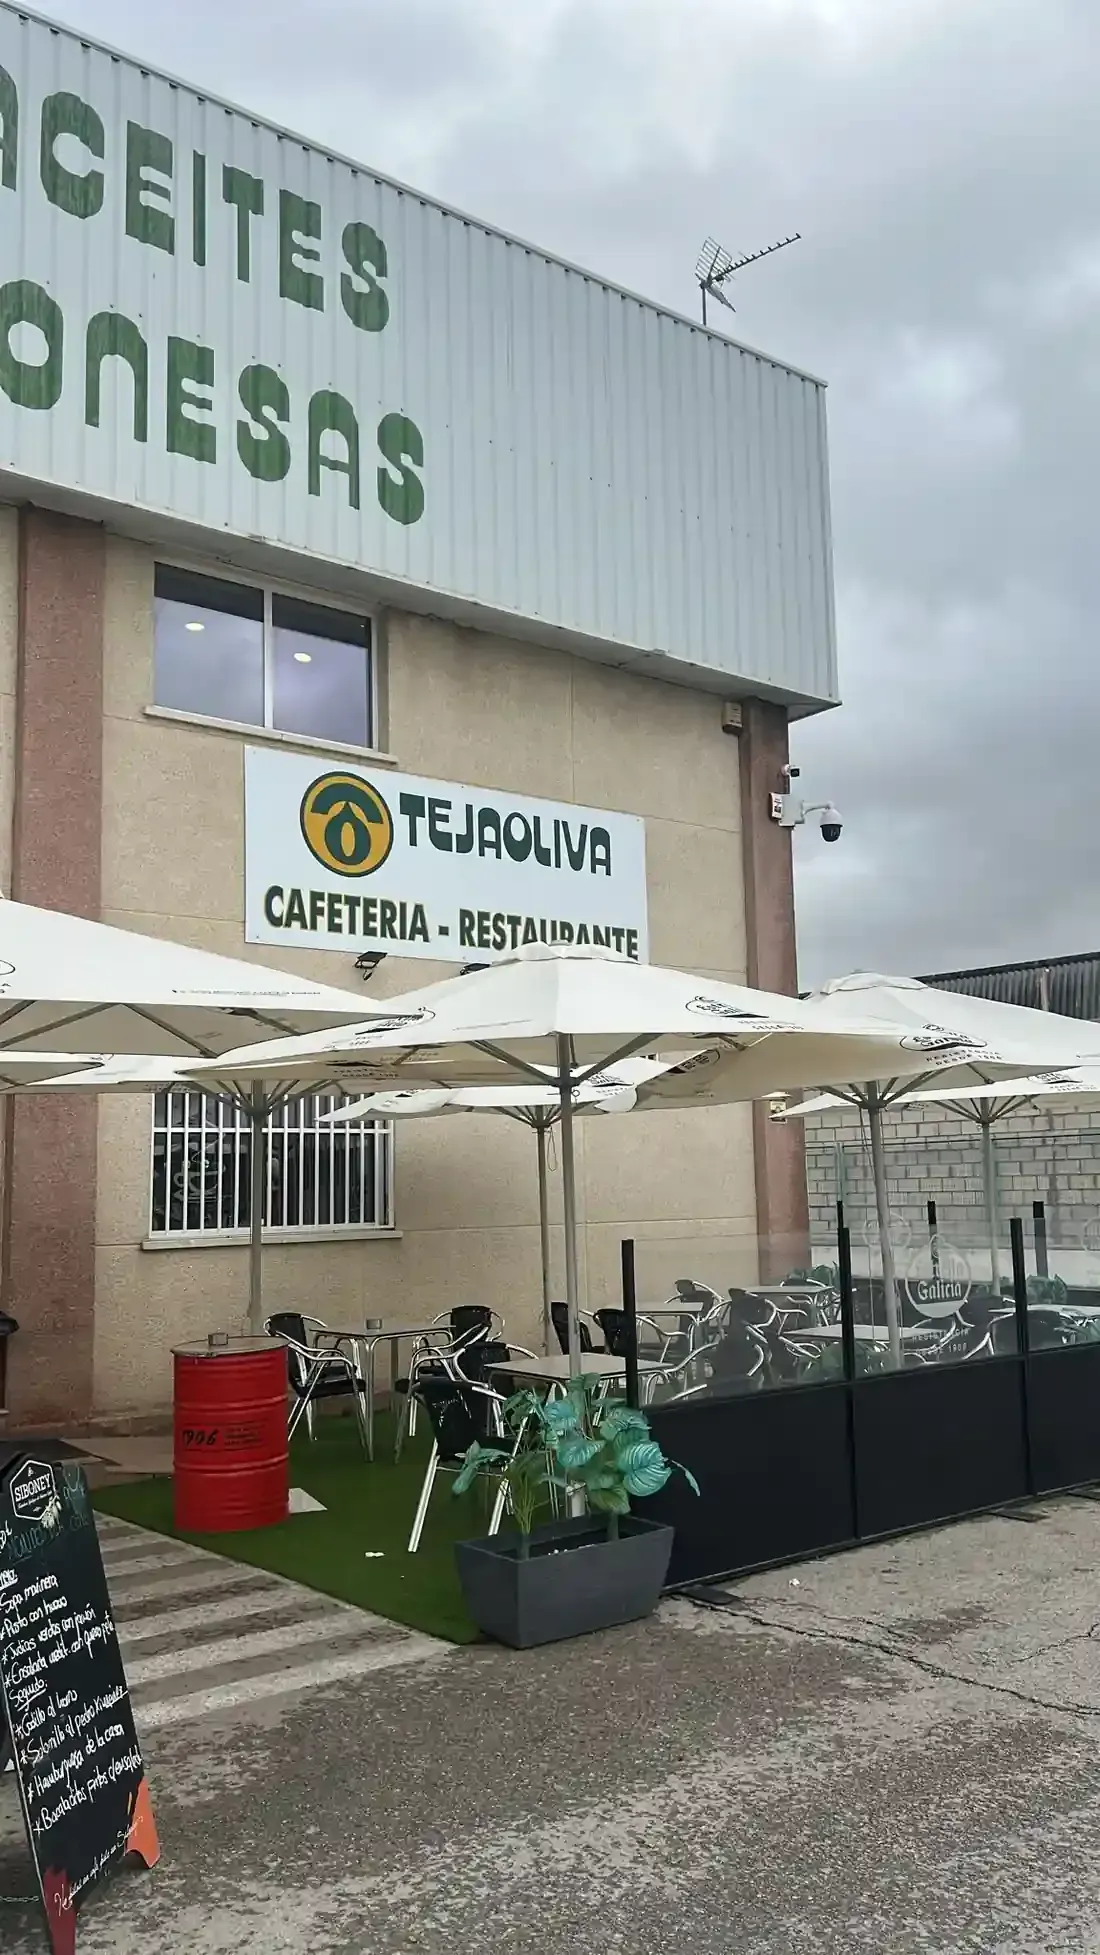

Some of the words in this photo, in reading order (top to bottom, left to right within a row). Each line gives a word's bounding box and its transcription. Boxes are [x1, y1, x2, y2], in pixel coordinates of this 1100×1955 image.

[399, 791, 612, 877] TEJAOLIVA
[263, 884, 430, 943] CAFETERIA
[458, 907, 639, 962] RESTAURANTE
[916, 1279, 962, 1301] Galicia
[14, 1473, 51, 1502] SIBONEY
[28, 1607, 44, 1623] con
[61, 1616, 75, 1632] con
[71, 1638, 84, 1653] con
[47, 1695, 57, 1718] al
[85, 1733, 98, 1755] de
[94, 1726, 105, 1747] la
[103, 1723, 125, 1743] casa
